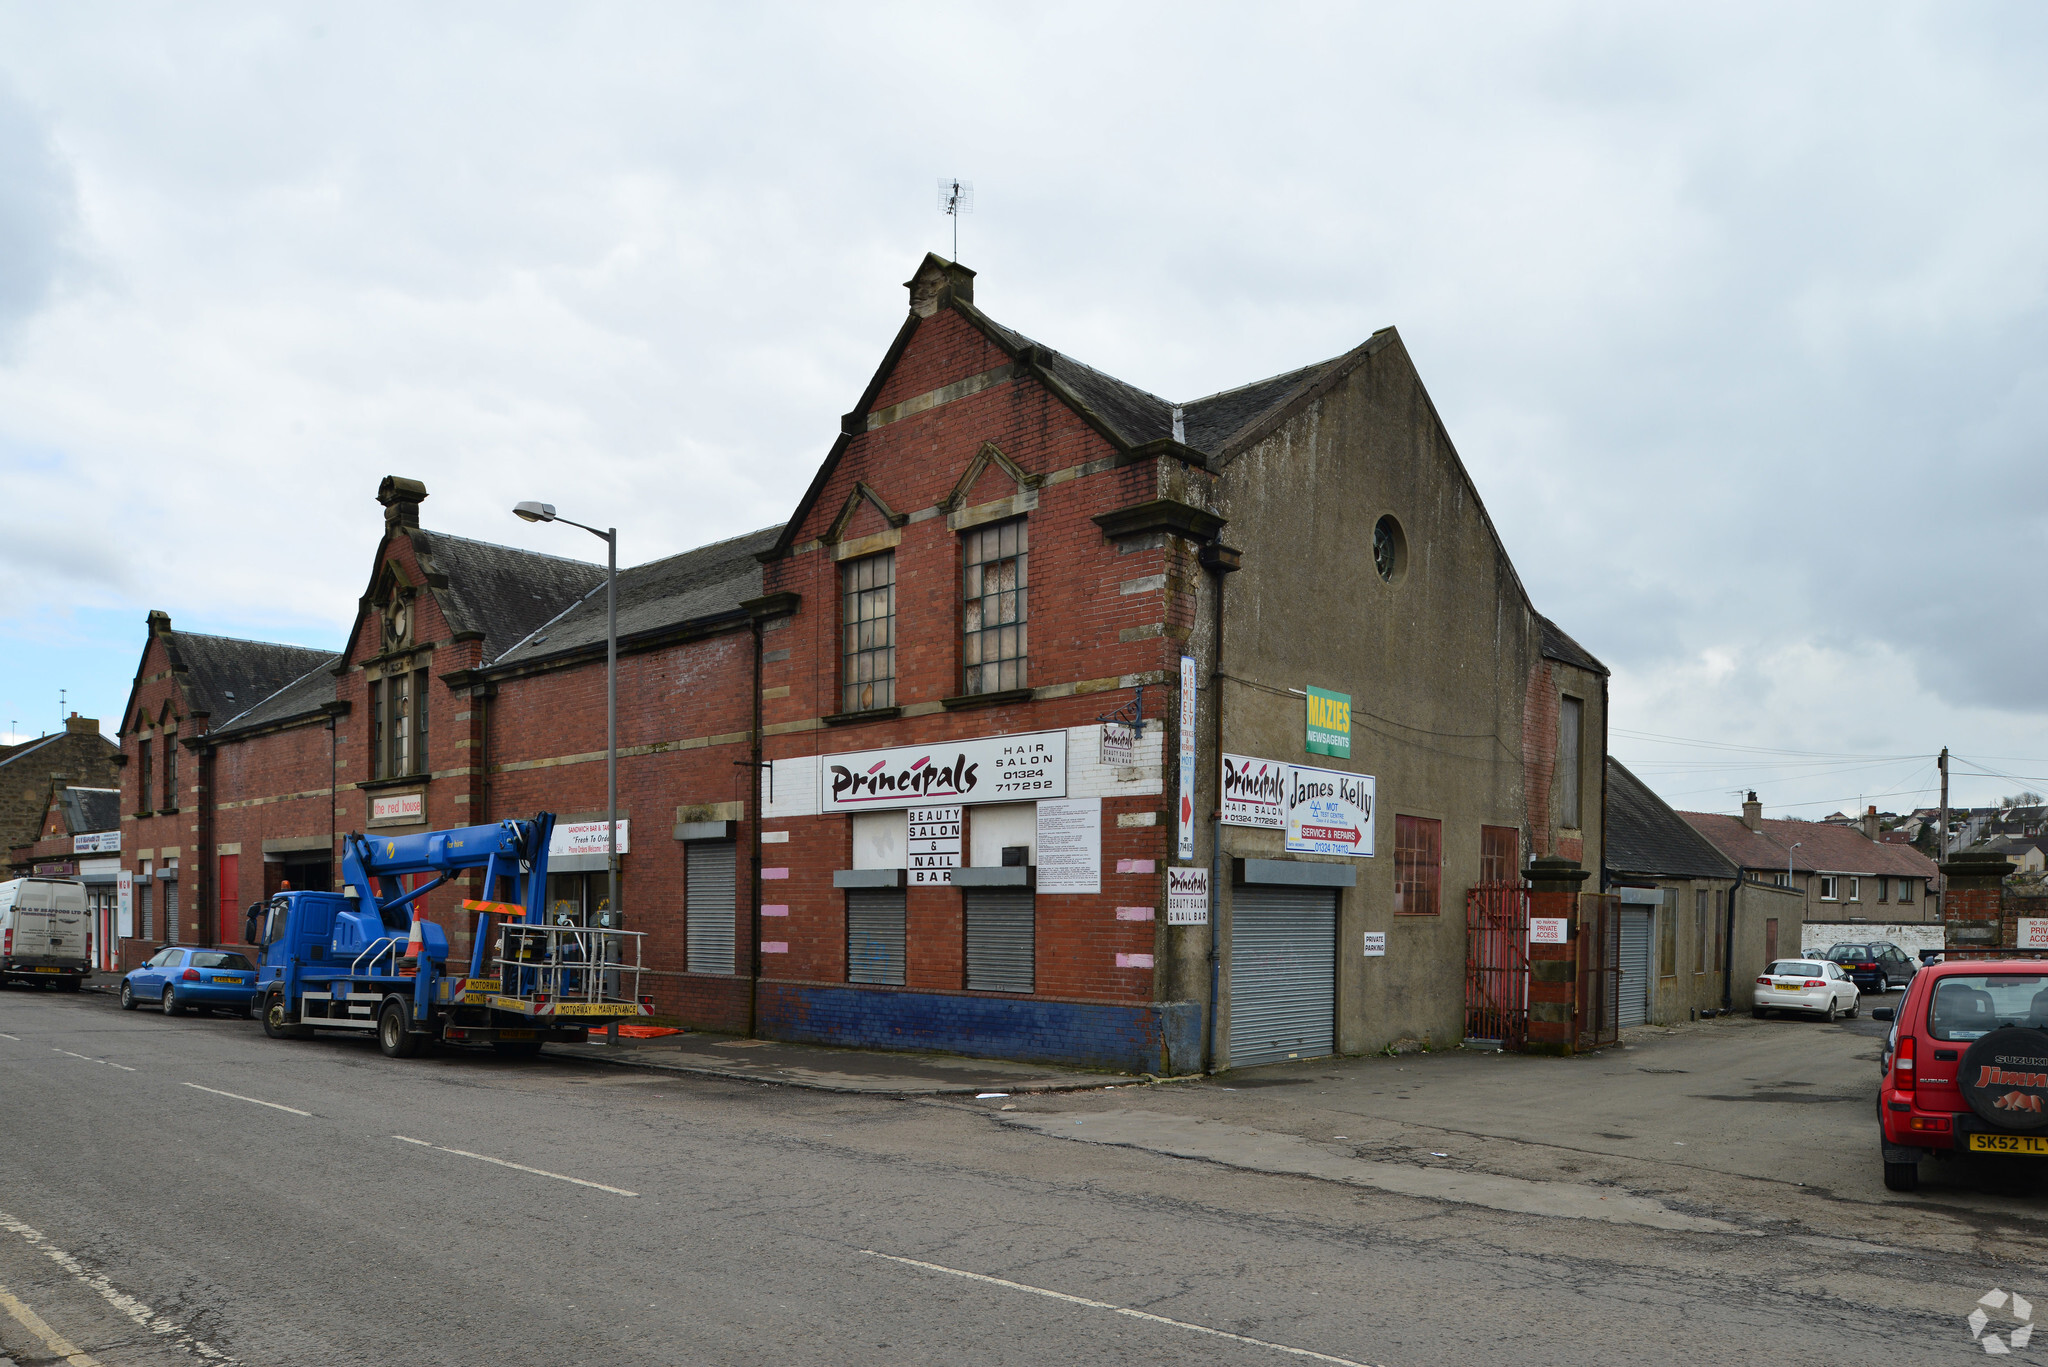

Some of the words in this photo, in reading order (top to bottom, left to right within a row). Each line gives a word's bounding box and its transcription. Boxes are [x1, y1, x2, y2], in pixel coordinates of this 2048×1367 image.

[1309, 694, 1350, 733] MAZIES
[1104, 729, 1133, 750] Principals
[1308, 730, 1349, 748] NEWSAGENTS
[1004, 744, 1044, 755] HAIR
[996, 755, 1053, 767] SALON
[1181, 756, 1192, 765] MOT
[830, 753, 979, 802] Principals
[1003, 769, 1044, 780] 01324
[996, 780, 1053, 792] 717292
[1225, 759, 1284, 805] Principals
[1290, 772, 1334, 809] James
[1340, 778, 1371, 822] Kelly
[375, 803, 384, 814] the
[388, 800, 399, 814] red
[402, 800, 420, 812] house
[1225, 803, 1246, 812] HAIR
[1255, 806, 1283, 816] SALON
[1326, 802, 1339, 811] MOT
[910, 809, 960, 822] BEAUTY
[1254, 817, 1277, 825] 717292
[910, 825, 960, 837] SALON
[1302, 828, 1326, 837] SERVICE
[1328, 830, 1331, 838] &
[1334, 831, 1355, 840] REPAIRS
[931, 841, 937, 851] &
[1315, 842, 1330, 852] 01324
[1332, 844, 1349, 854] 714113
[915, 856, 953, 867] NAIL
[916, 872, 951, 882] BAR
[1170, 871, 1206, 895] Principals
[1170, 899, 1189, 908] BEAUTY
[1191, 899, 1206, 908] SALON
[1176, 912, 1191, 920] NAIL
[1194, 912, 1206, 920] BAR
[470, 981, 500, 989] MOTORWAY
[465, 993, 486, 1002] MAINTE
[561, 1005, 591, 1014] MOTORWAY
[599, 1005, 636, 1014] MAINTENANCE
[1995, 1055, 2048, 1066] SUZUKI
[1974, 1065, 2048, 1088] Jimn
[1977, 1136, 2019, 1150] SK52
[2023, 1138, 2048, 1151] TL
